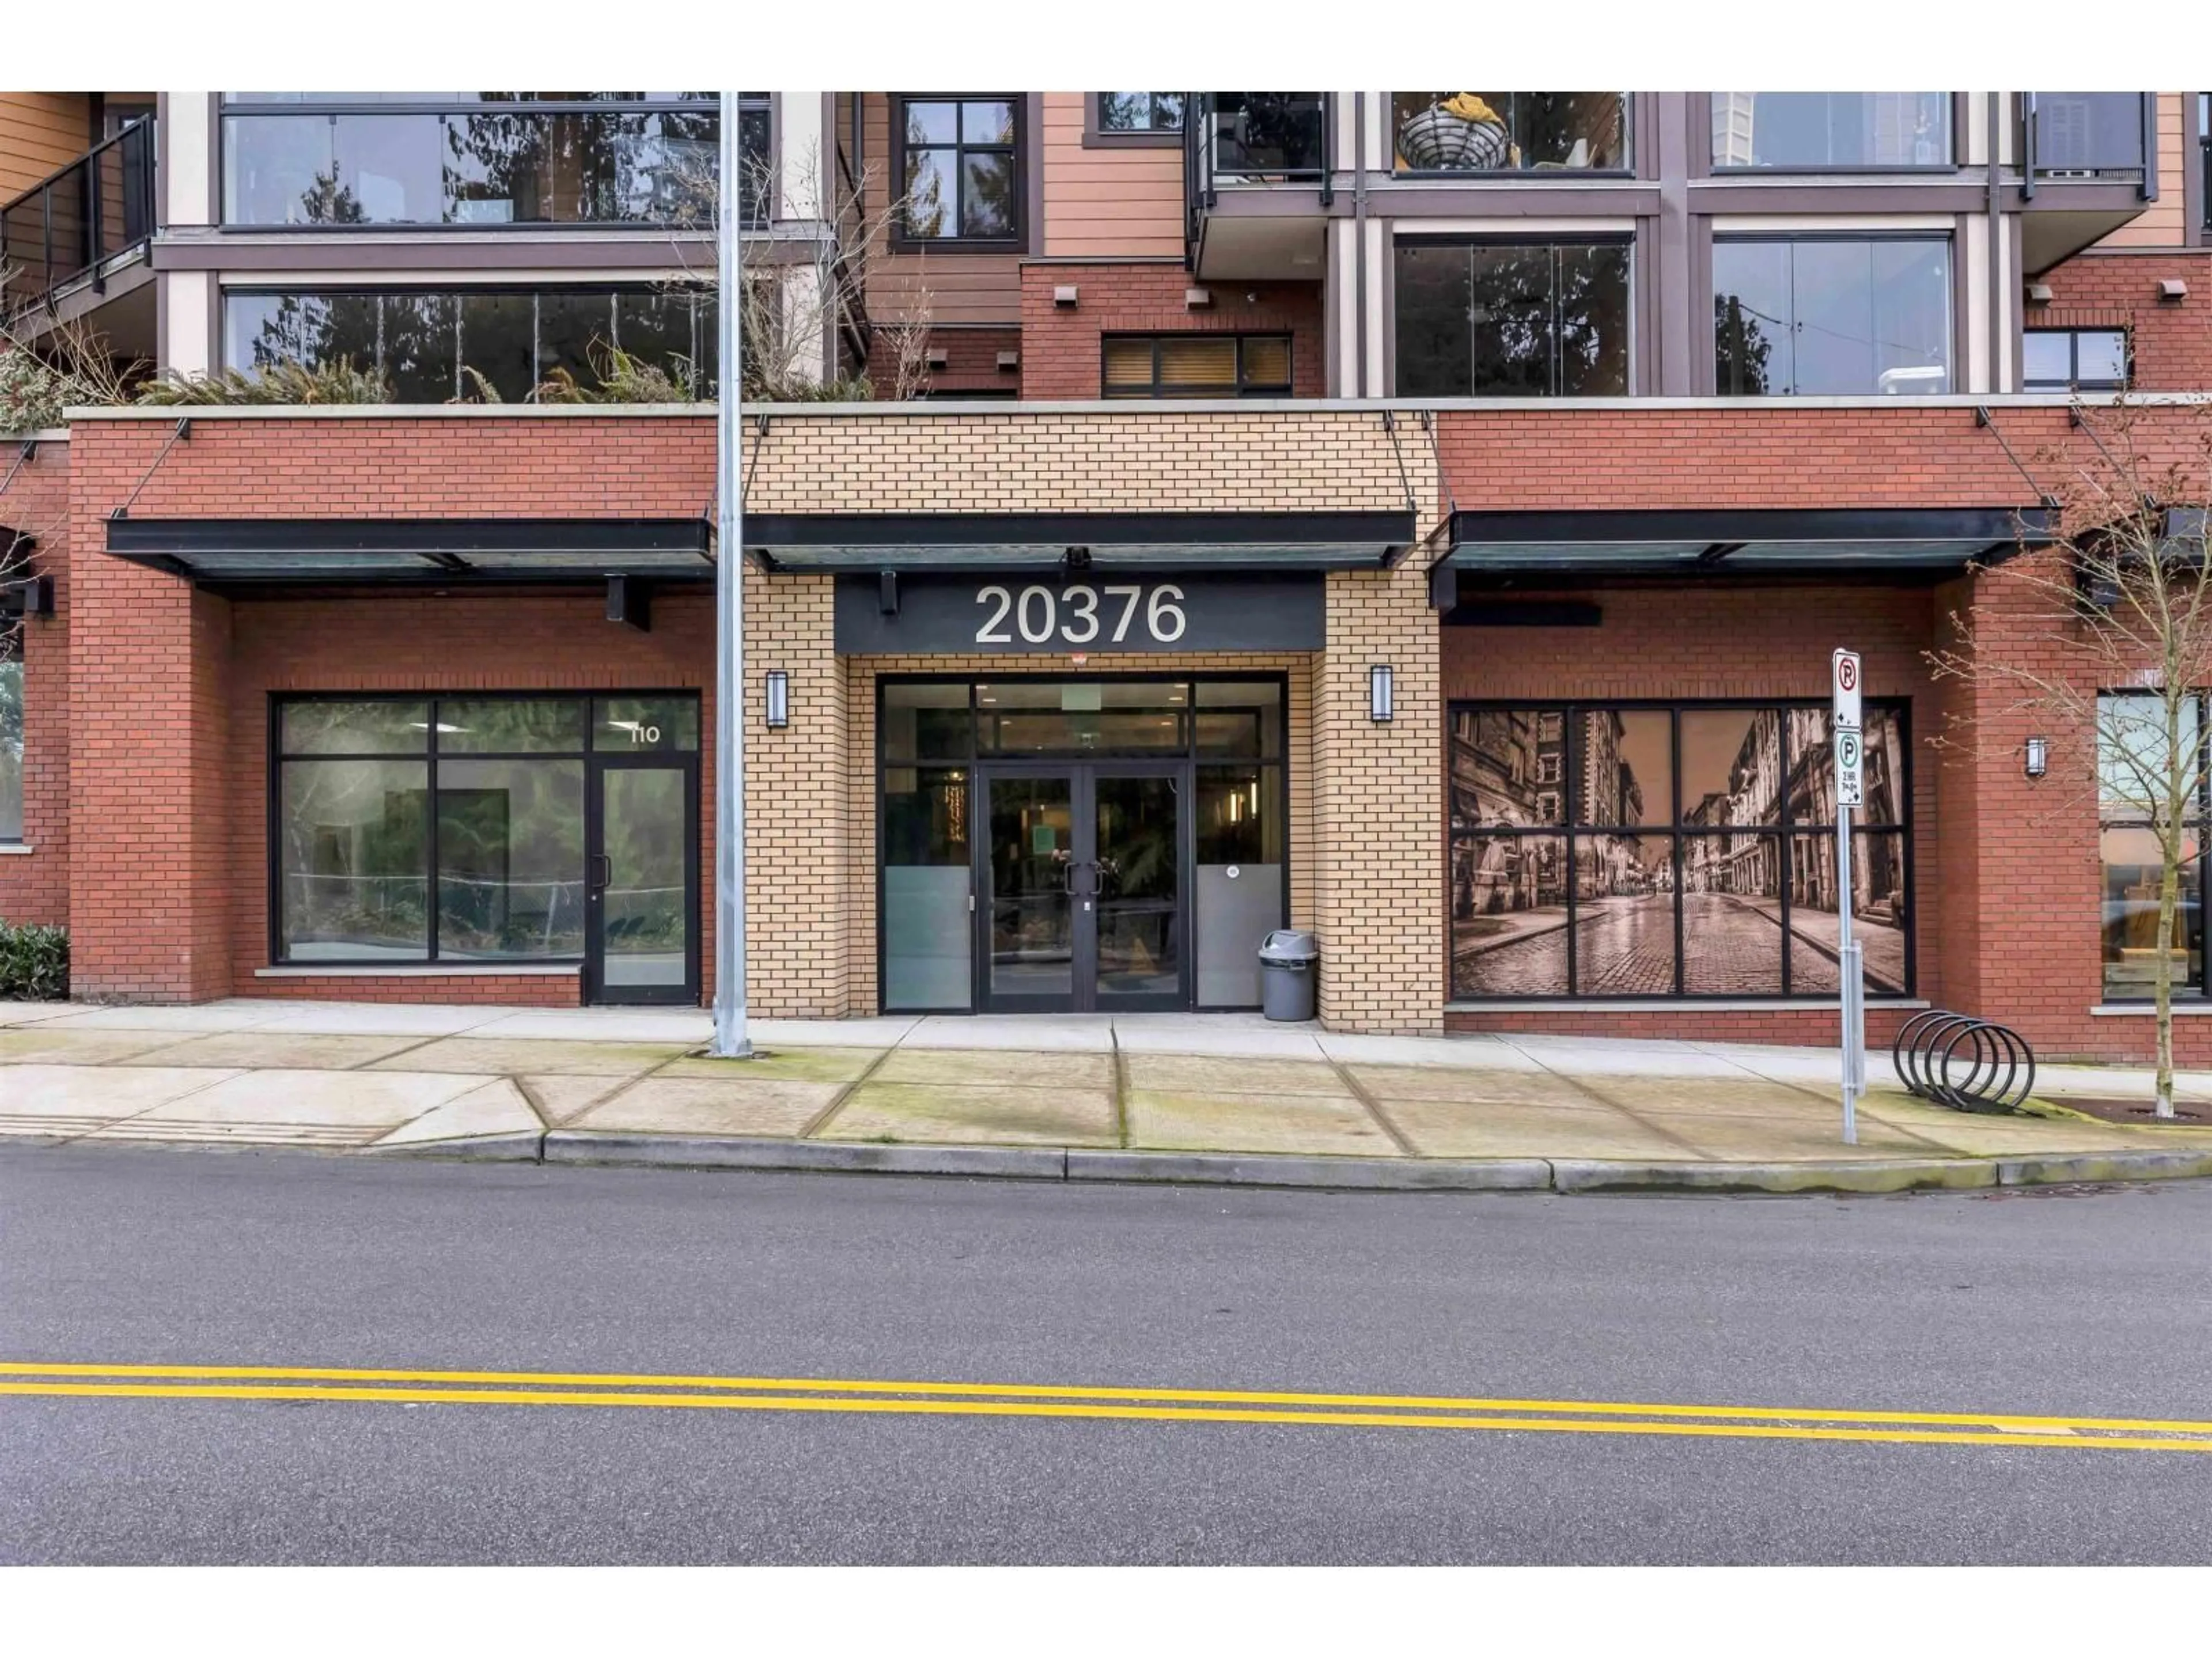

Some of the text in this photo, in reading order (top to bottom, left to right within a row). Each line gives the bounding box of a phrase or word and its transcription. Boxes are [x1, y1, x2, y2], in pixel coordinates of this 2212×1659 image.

[976, 585, 1186, 643] 20376
[632, 726, 660, 743] 110
[1844, 741, 1854, 760] P
